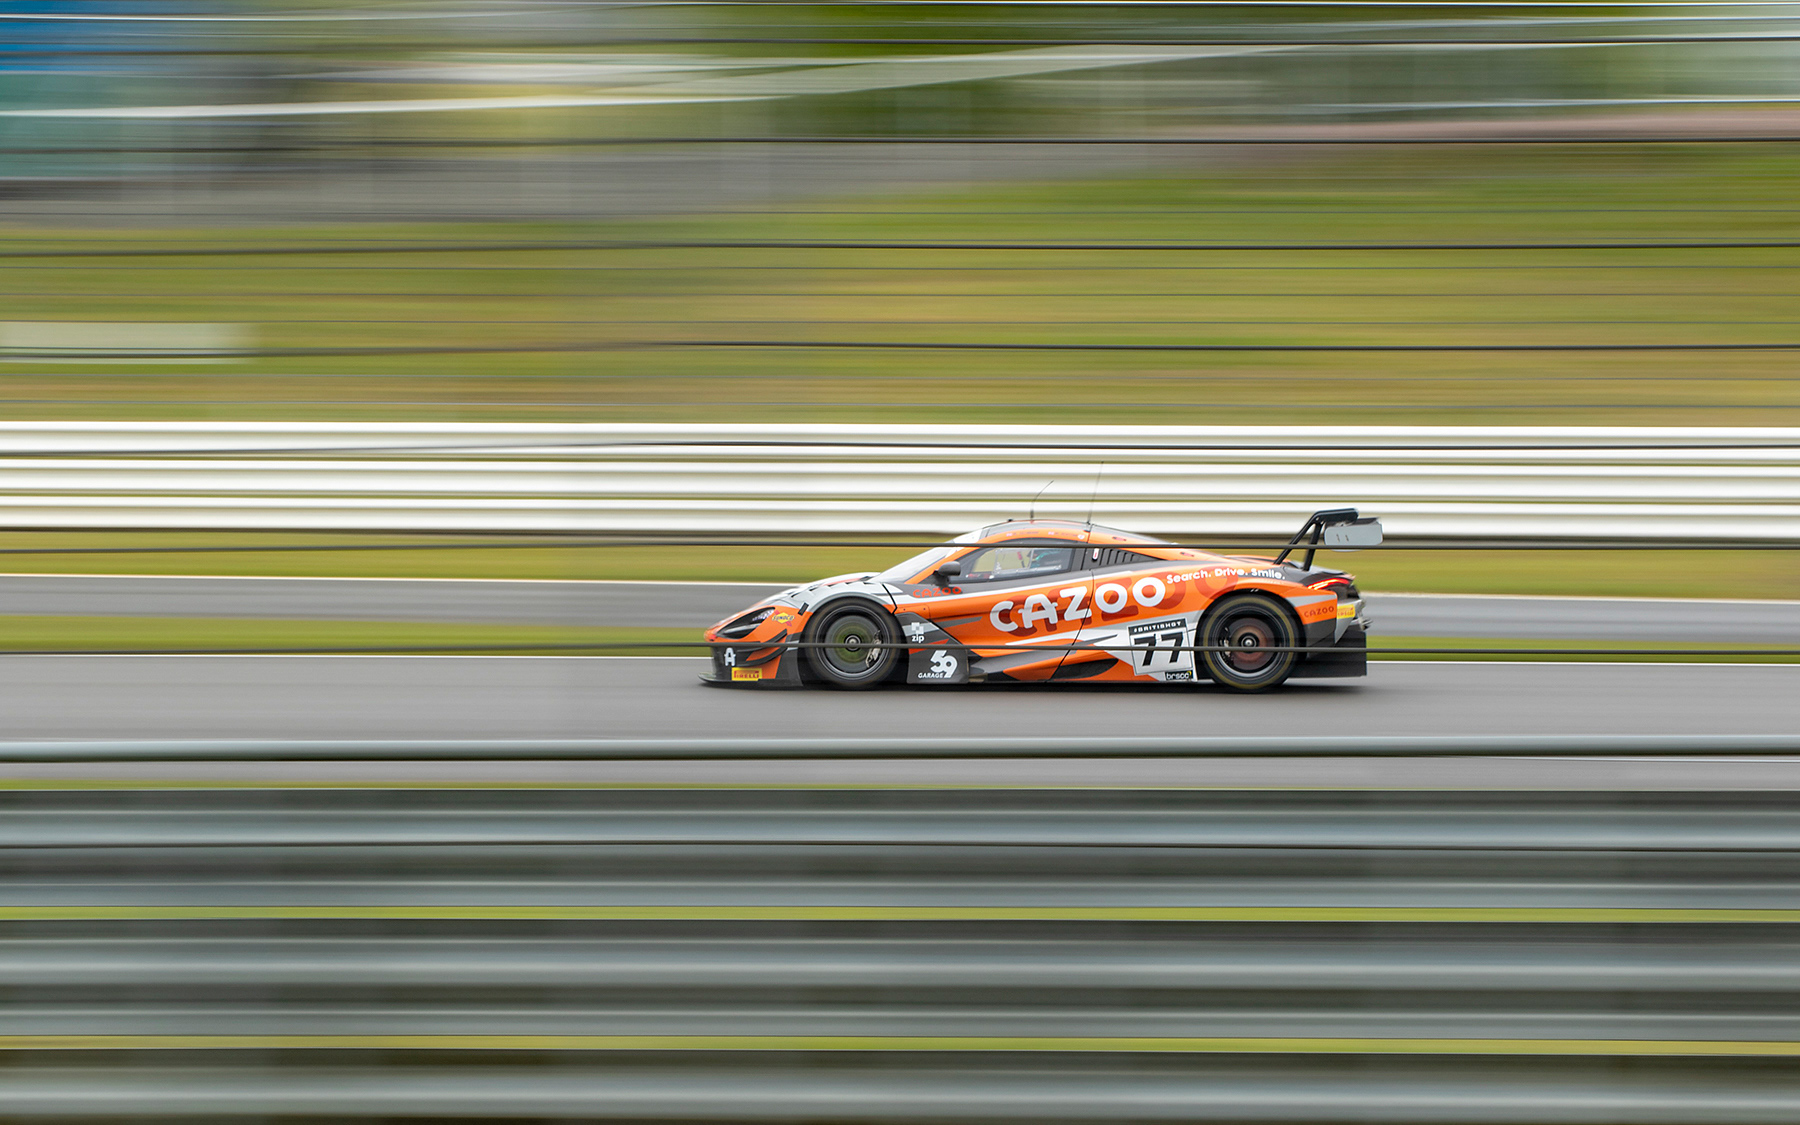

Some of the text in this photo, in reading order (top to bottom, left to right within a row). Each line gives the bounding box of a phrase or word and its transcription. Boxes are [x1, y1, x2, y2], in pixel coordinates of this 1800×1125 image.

[1166, 568, 1286, 584] Search. Drive. Smile.
[913, 586, 961, 598] CAZOO
[989, 576, 1166, 632] CAZOO
[1303, 606, 1335, 618] CAZOO
[911, 633, 925, 643] zip
[1134, 631, 1184, 666] 77
[734, 670, 760, 679] PIRELLI
